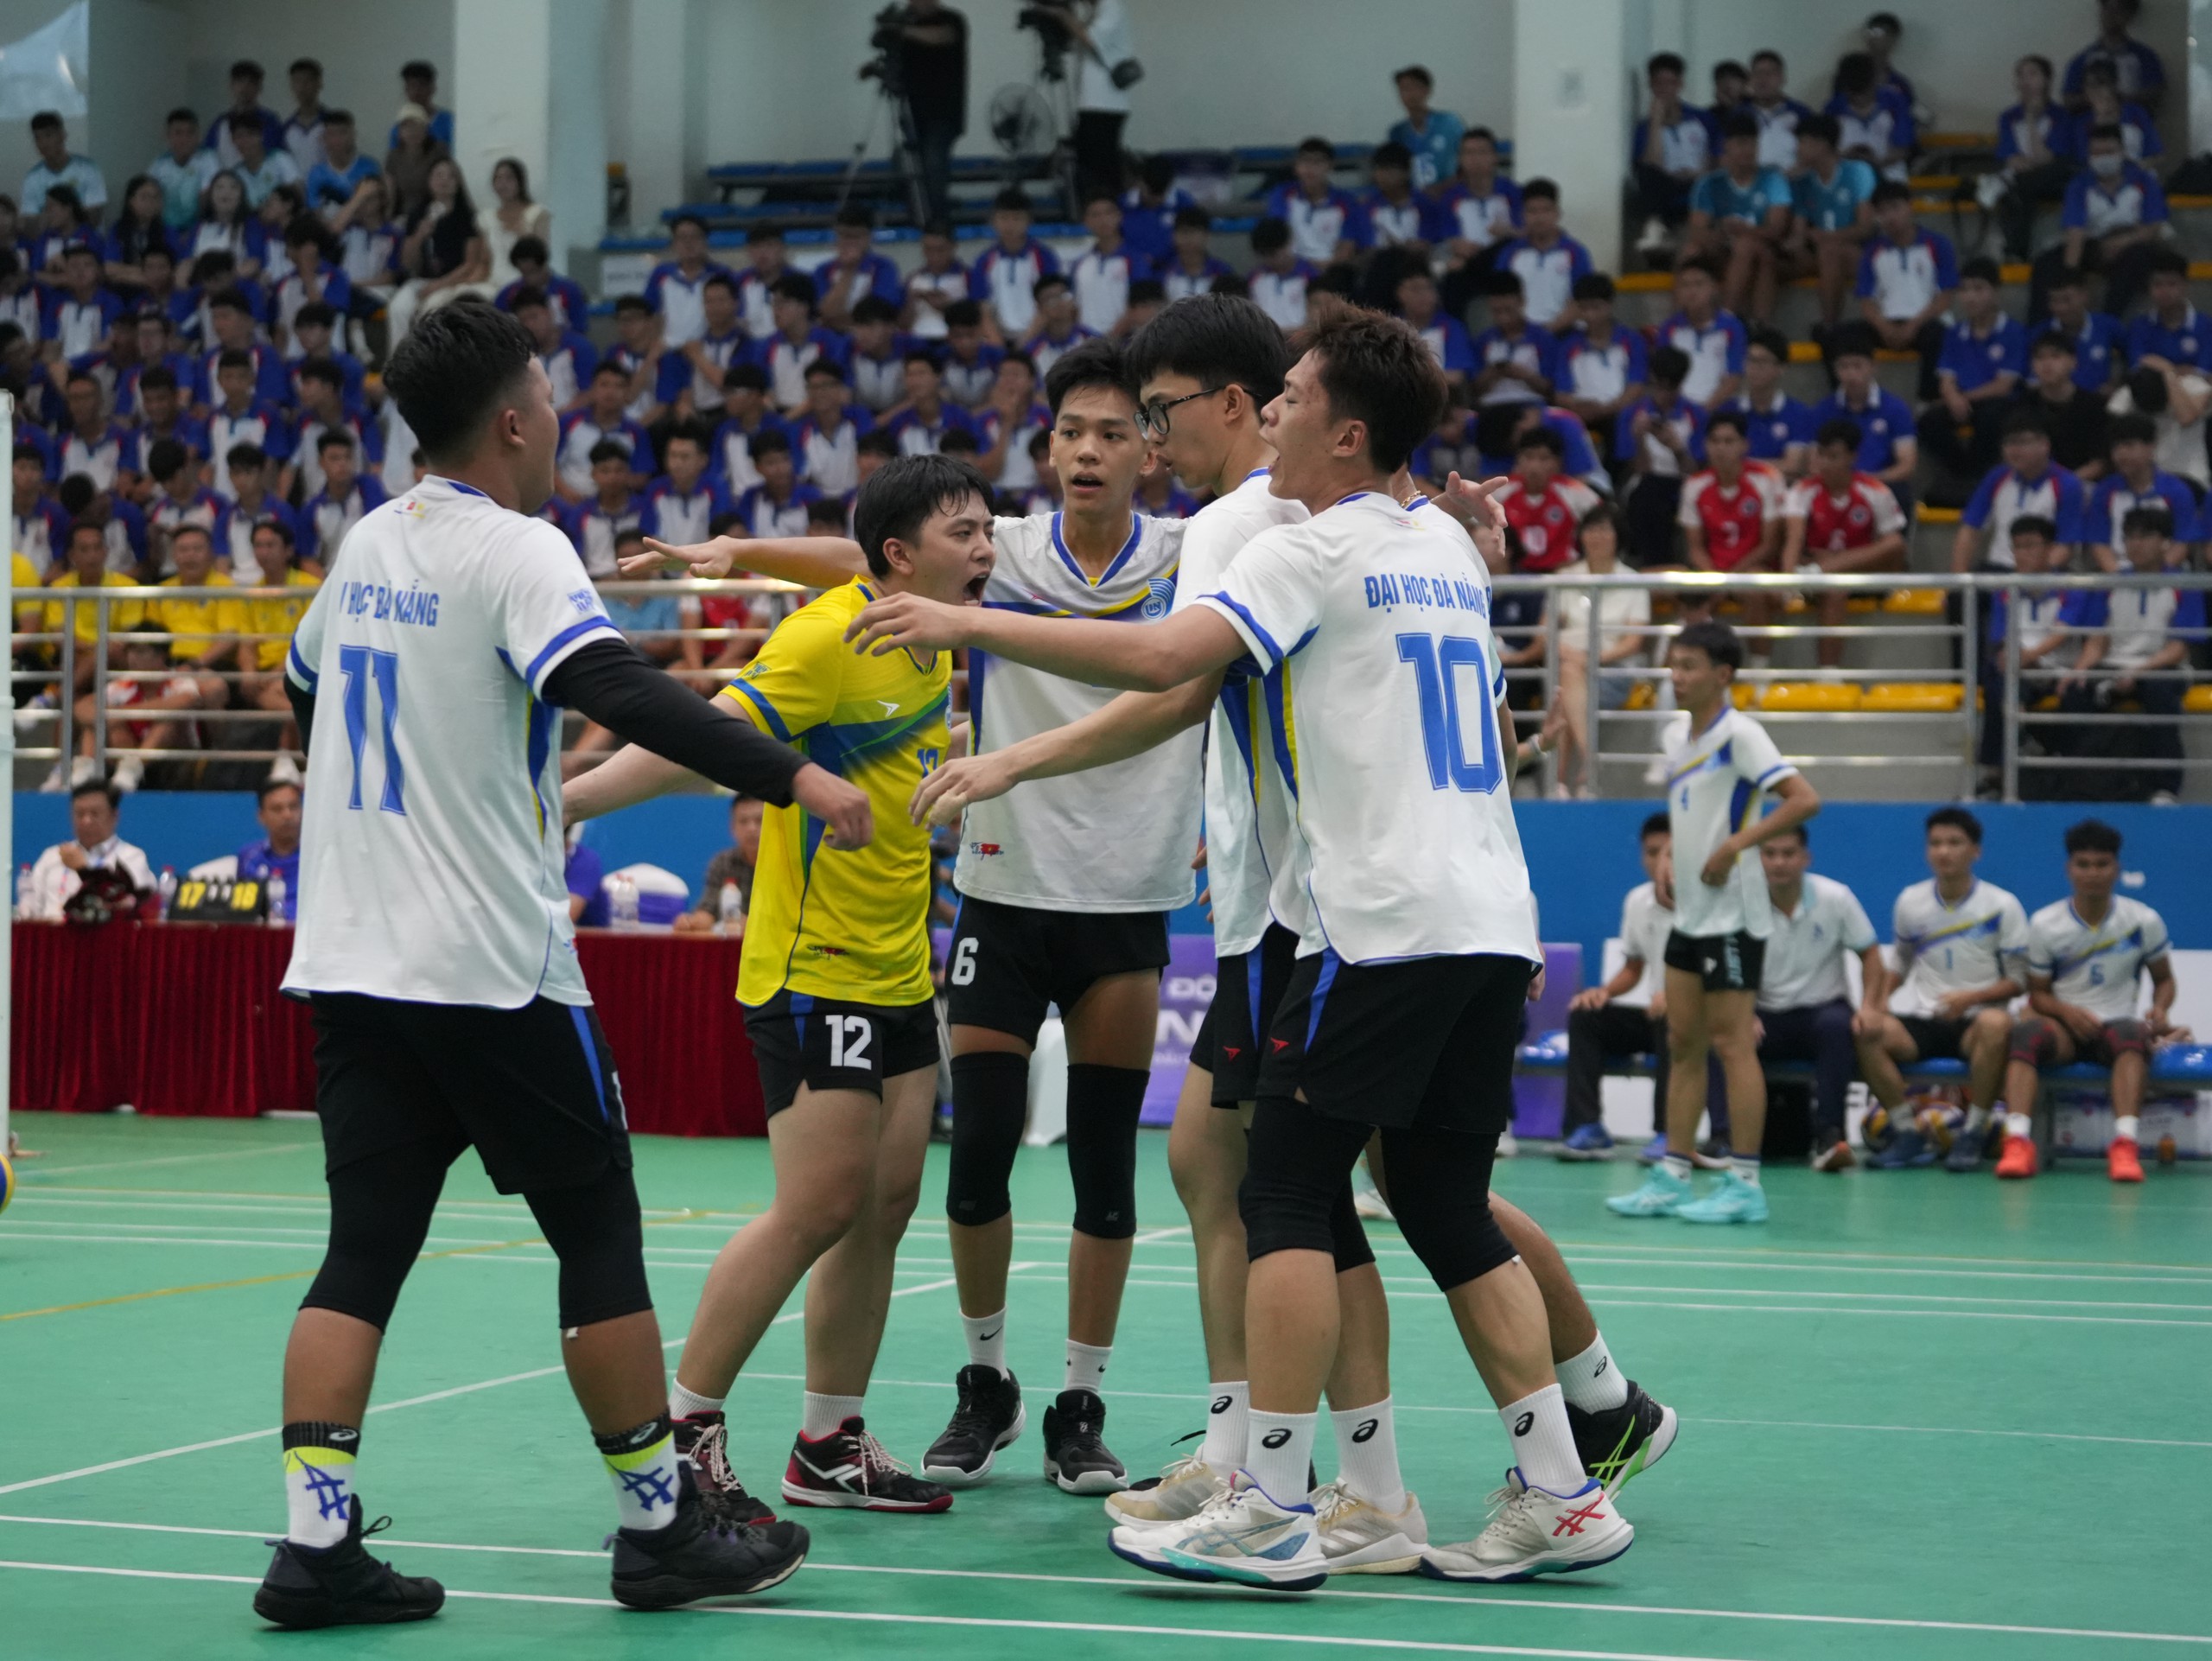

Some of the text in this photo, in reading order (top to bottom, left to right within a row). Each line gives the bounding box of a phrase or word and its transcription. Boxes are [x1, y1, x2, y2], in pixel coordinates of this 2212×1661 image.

[1364, 574, 1400, 613] ĐẠI
[1400, 574, 1432, 612] HỌC
[1431, 573, 1456, 609] ĐÀ
[339, 644, 406, 816] 11
[1395, 632, 1503, 795] 10
[178, 881, 206, 909] 17
[951, 937, 979, 986] 6
[825, 1015, 872, 1070] 12
